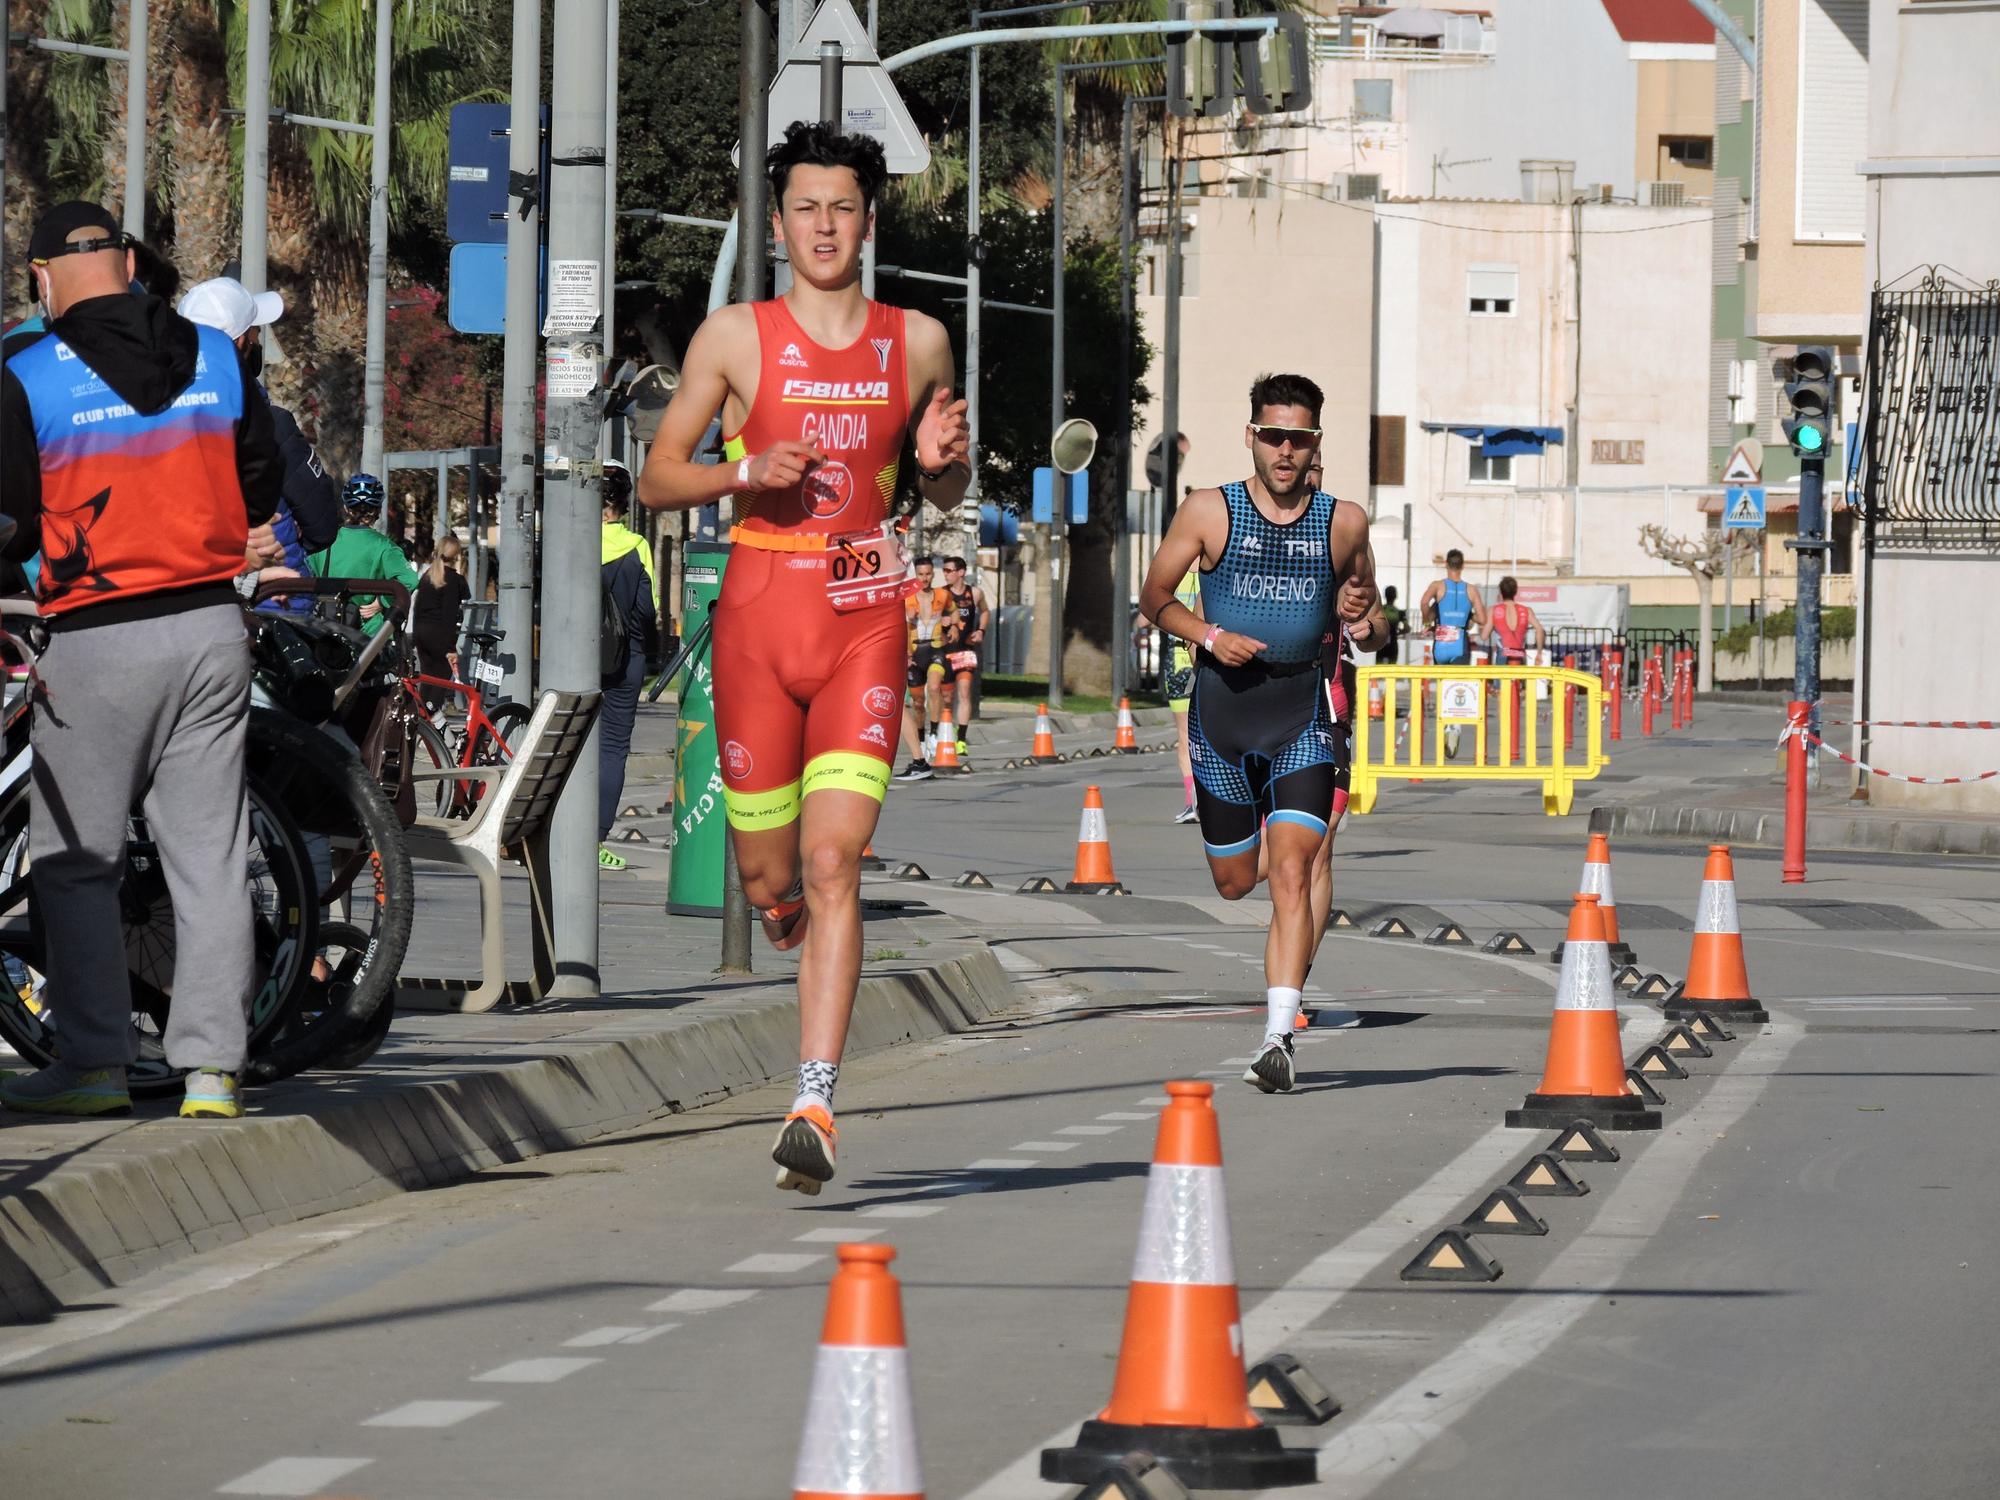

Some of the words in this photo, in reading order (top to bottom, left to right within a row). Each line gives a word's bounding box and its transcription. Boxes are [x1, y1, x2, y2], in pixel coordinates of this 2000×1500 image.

[550, 372, 592, 381] CONÓMICOS
[572, 363, 593, 372] SÚPER
[783, 379, 889, 399] ISBILYA
[72, 407, 105, 426] CLUB
[105, 404, 136, 420] TRIA
[801, 412, 867, 450] GANDIA
[833, 550, 881, 581] 079
[1232, 572, 1317, 602] MORENO
[487, 667, 499, 677] 121
[353, 967, 365, 986] DT
[361, 938, 379, 968] SWISS
